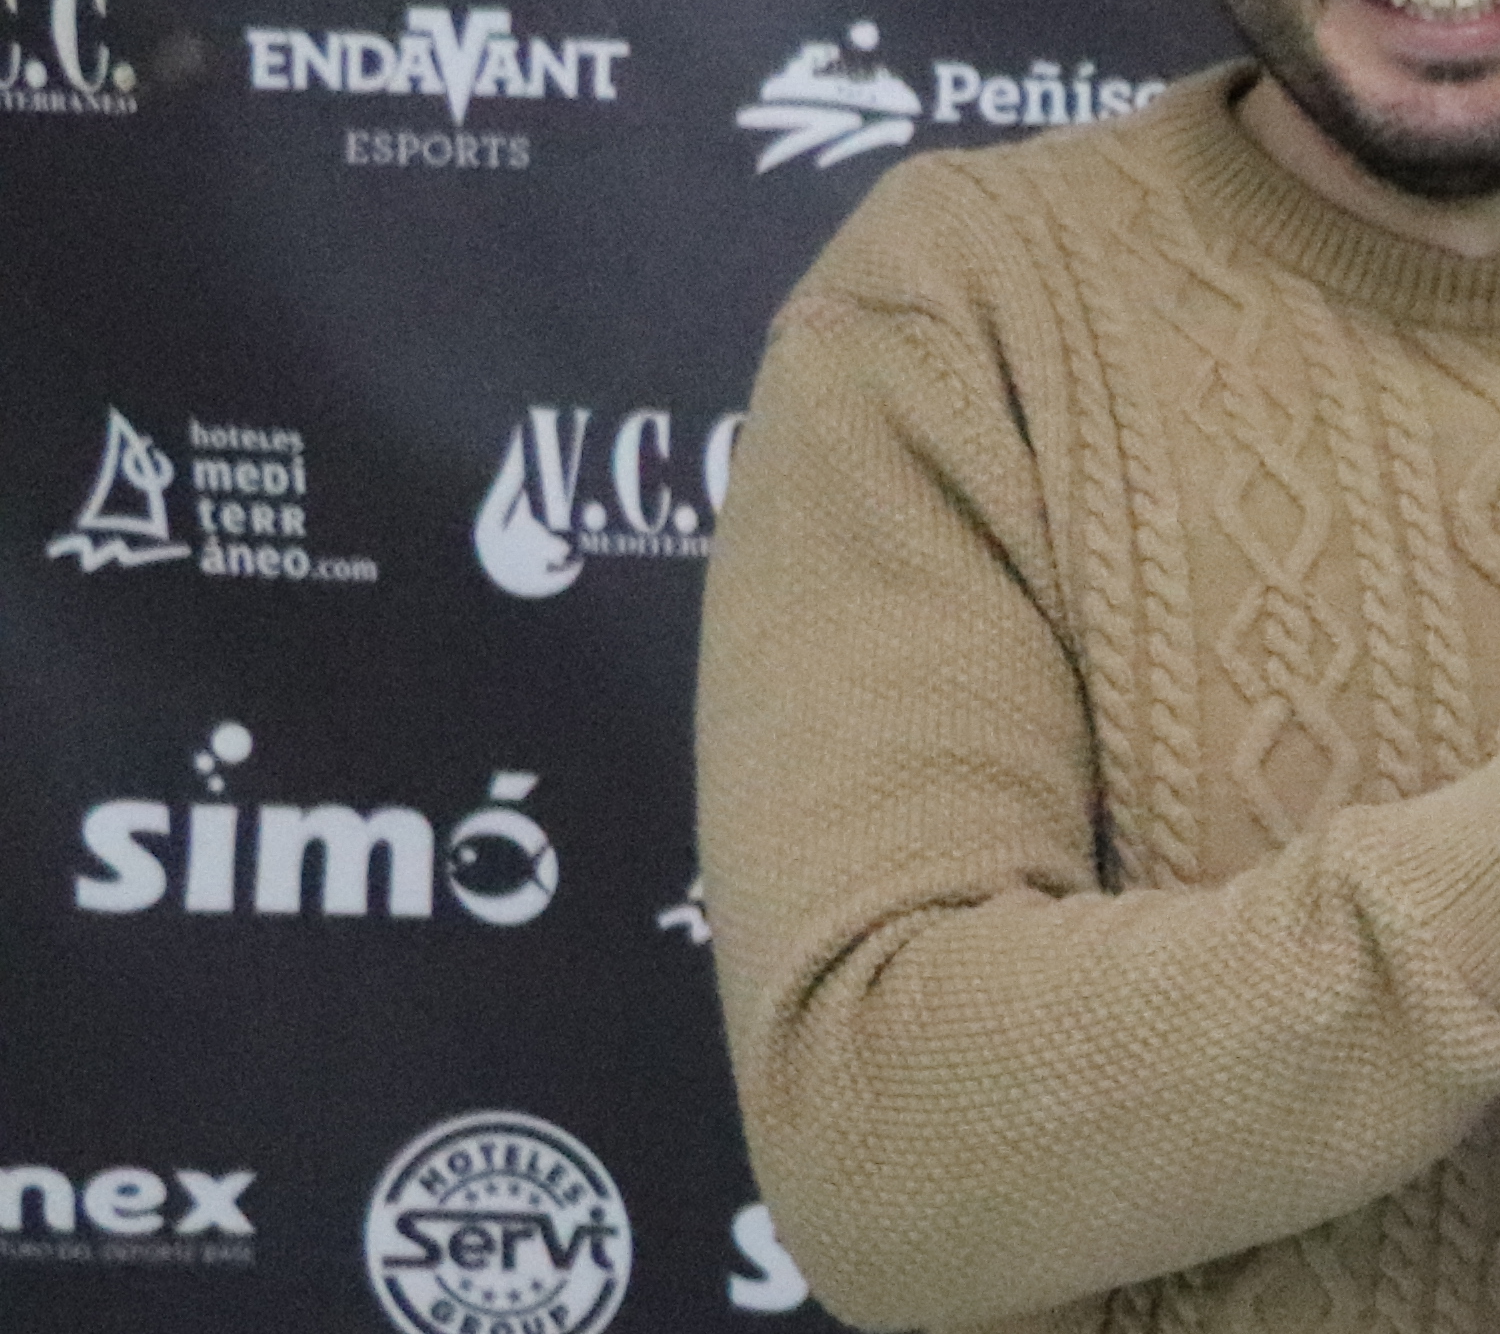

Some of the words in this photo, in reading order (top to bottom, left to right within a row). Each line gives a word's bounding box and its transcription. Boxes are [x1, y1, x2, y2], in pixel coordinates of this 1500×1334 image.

[246, 6, 631, 126] ENDAVANT
[346, 131, 531, 170] ESPORTS
[417, 1140, 584, 1209] HOTELES
